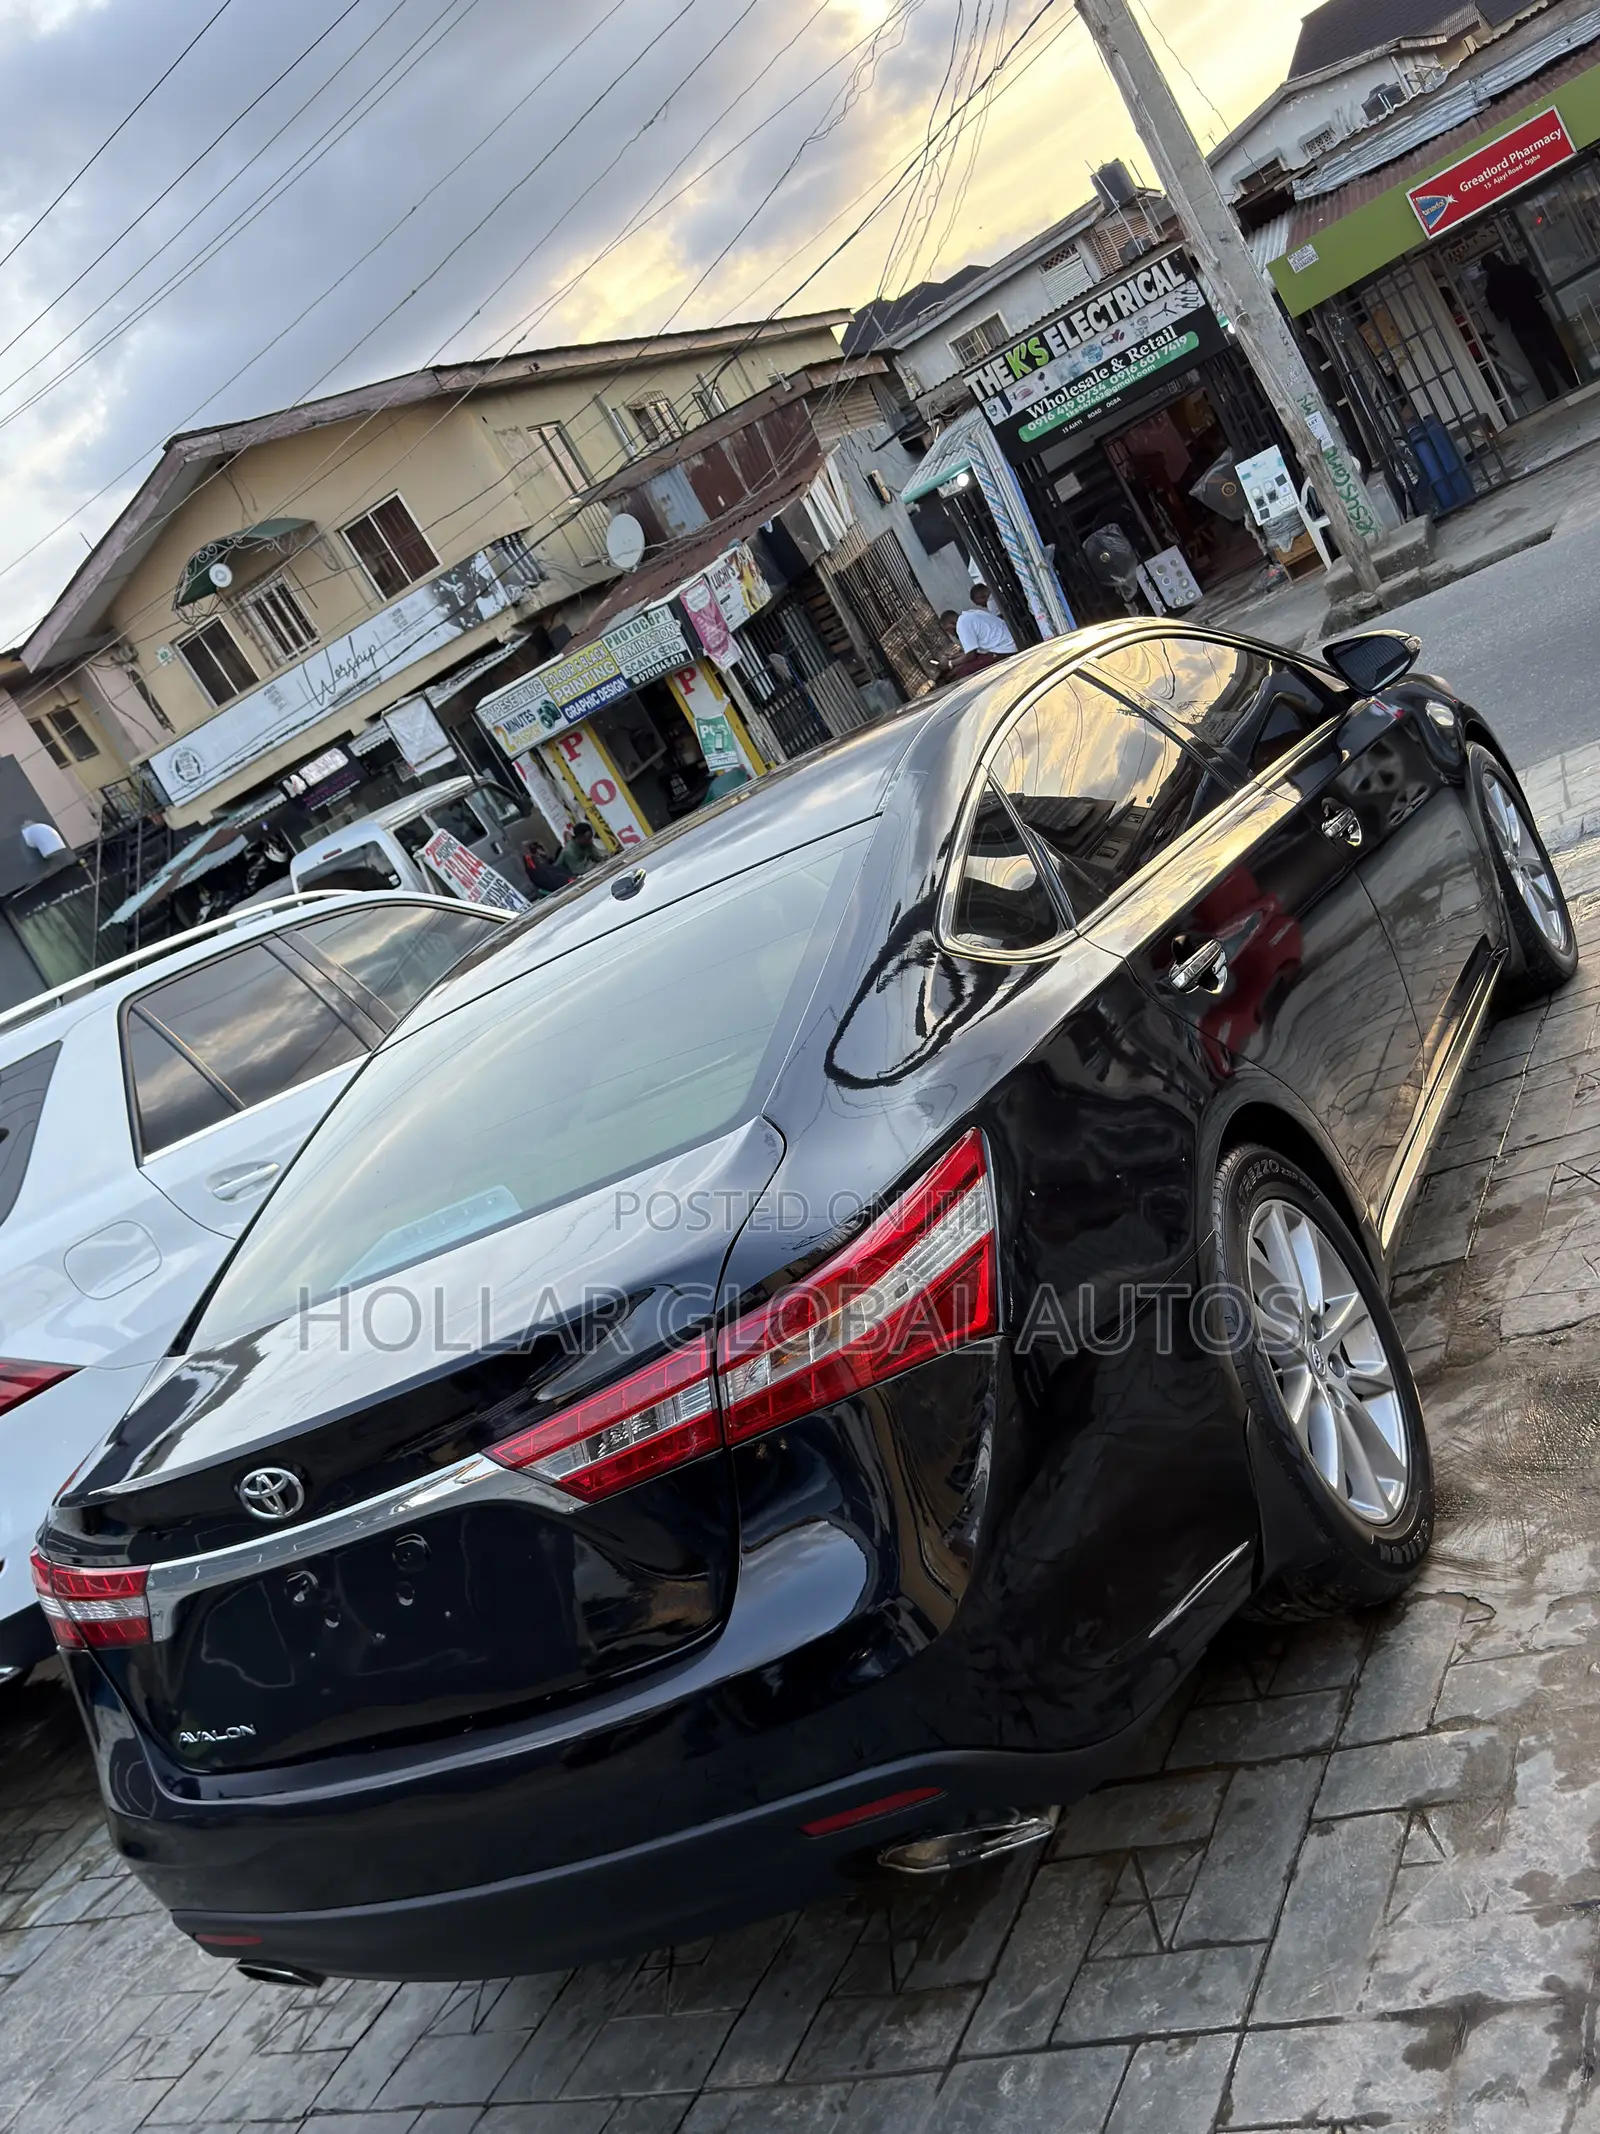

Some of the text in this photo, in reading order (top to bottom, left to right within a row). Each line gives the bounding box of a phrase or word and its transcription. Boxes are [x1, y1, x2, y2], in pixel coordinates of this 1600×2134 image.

[1460, 128, 1562, 191] Greatlord Pharmacy
[1483, 153, 1541, 190] 15 Ajayi Road Ogba
[1042, 257, 1185, 358] ELECTRICAL
[1025, 324, 1178, 419] Wholesale & Retail
[1026, 334, 1188, 432] 0916 419 0734 0916 601 7419
[1086, 407, 1102, 419] ROAD
[604, 607, 668, 648] PHOTOCOPY
[612, 622, 677, 663] LAMINATION
[301, 635, 378, 706] Worship
[542, 662, 576, 689] COLOUR
[579, 644, 608, 668] BLACK
[624, 639, 682, 675] SCAN & SEND
[480, 679, 544, 723] TYPESETTING
[552, 659, 616, 703] PRINTING
[563, 677, 627, 719] GRAPHIC DESIGN
[502, 708, 536, 735] MINUTES
[180, 1724, 257, 1742] AVALON
